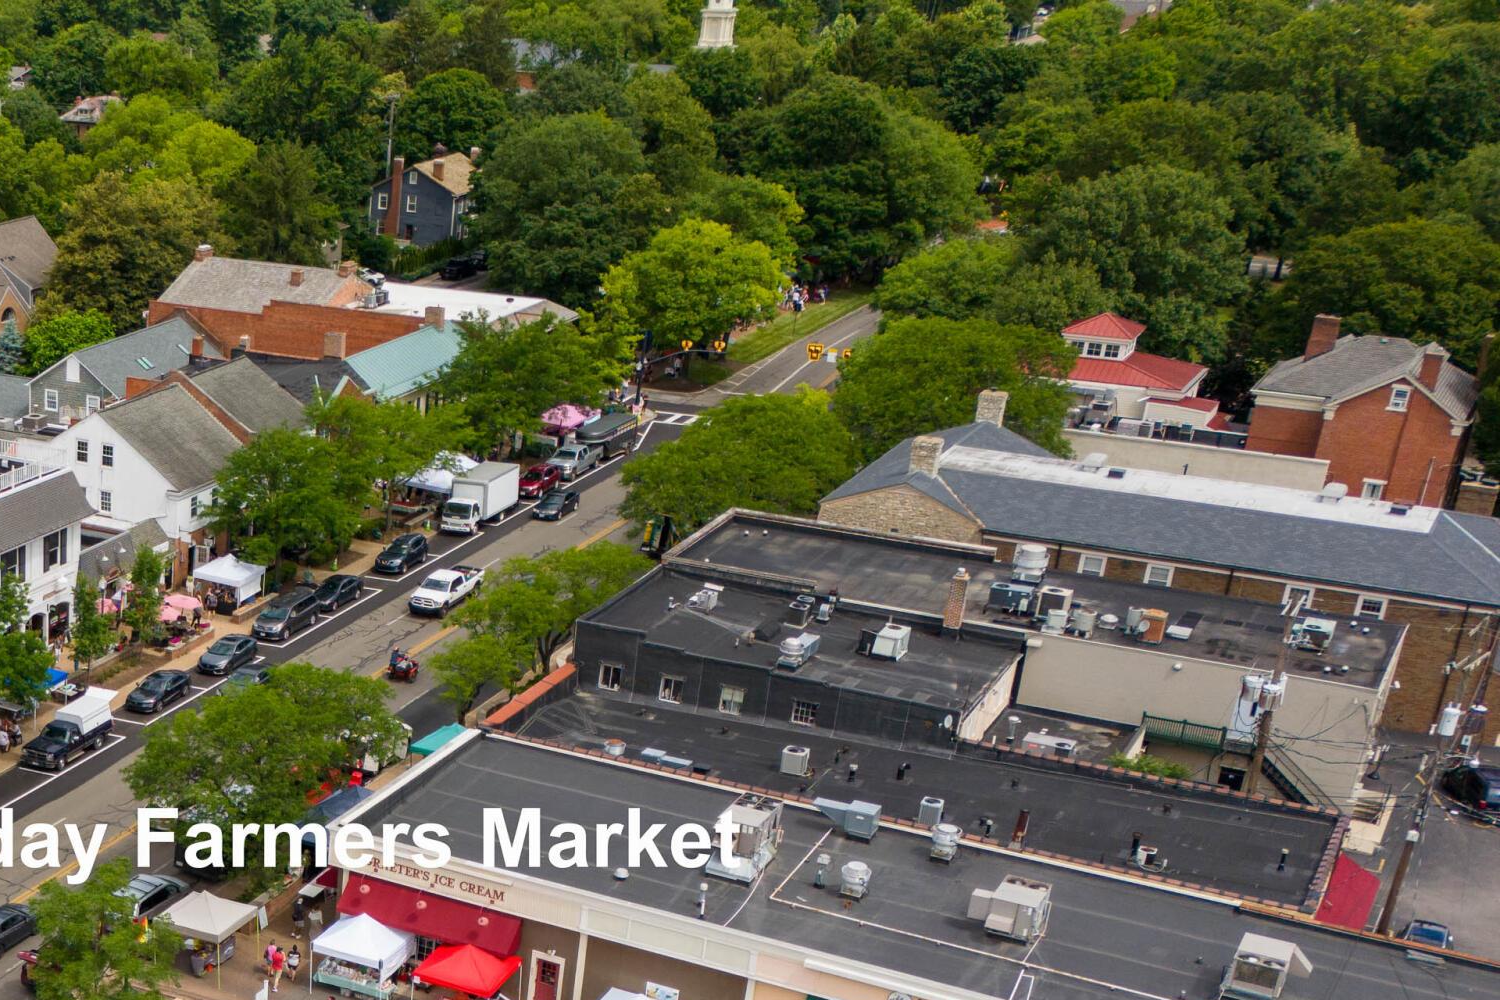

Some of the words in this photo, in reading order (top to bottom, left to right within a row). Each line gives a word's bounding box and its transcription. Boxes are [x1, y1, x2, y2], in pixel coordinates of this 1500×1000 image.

[366, 857, 430, 882] RETER'S
[435, 873, 455, 889] ICE
[459, 881, 506, 902] CREAM
